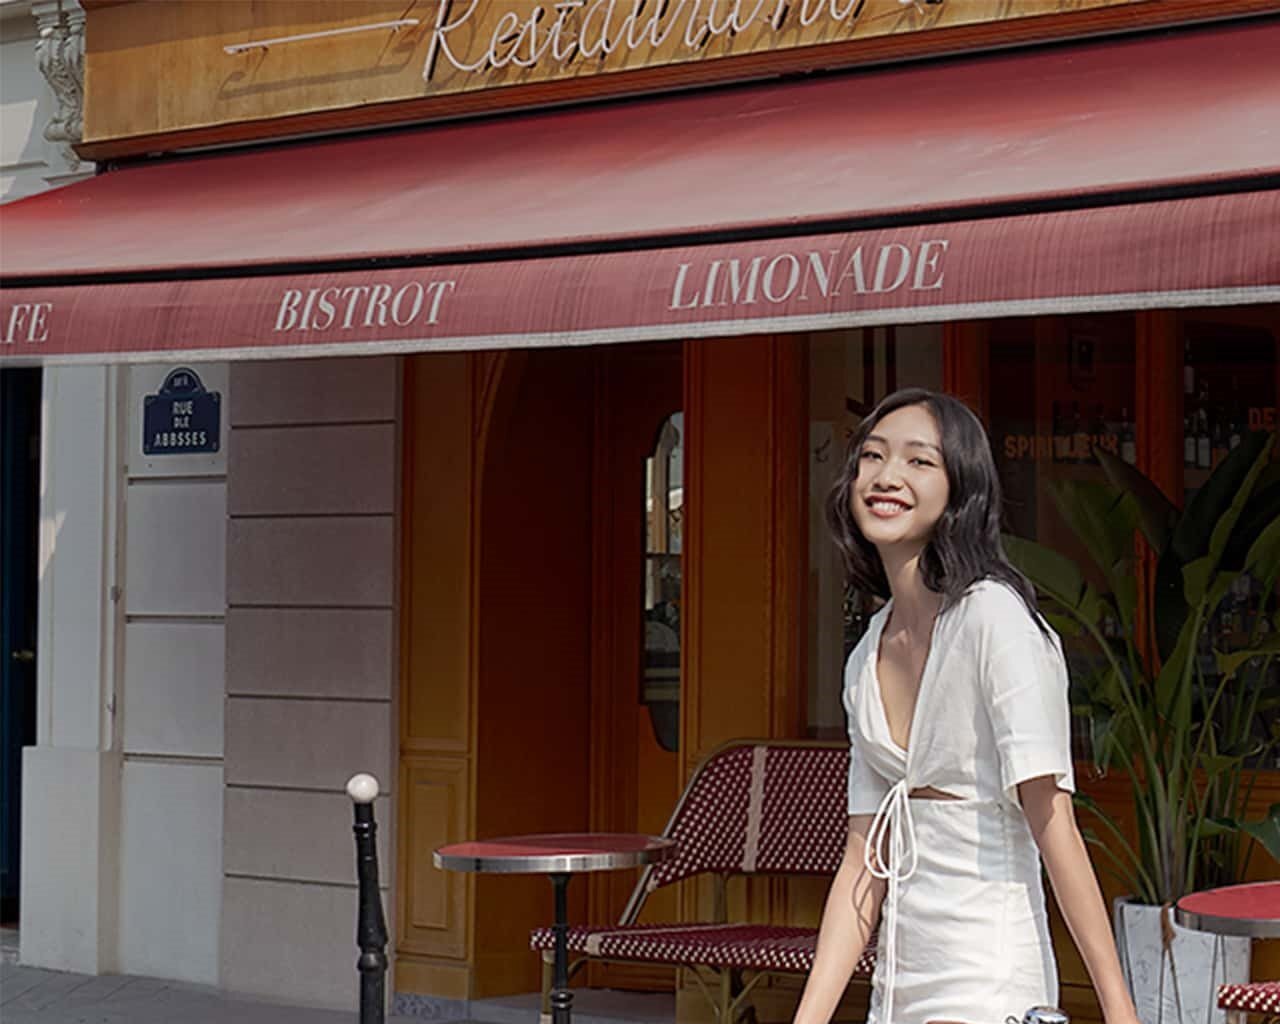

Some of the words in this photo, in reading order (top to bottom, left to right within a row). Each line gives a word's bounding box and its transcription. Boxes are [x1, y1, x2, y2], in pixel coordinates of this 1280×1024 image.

[668, 239, 950, 310] LIMONADE
[0, 302, 53, 344] FE
[273, 279, 456, 332] BISTROT
